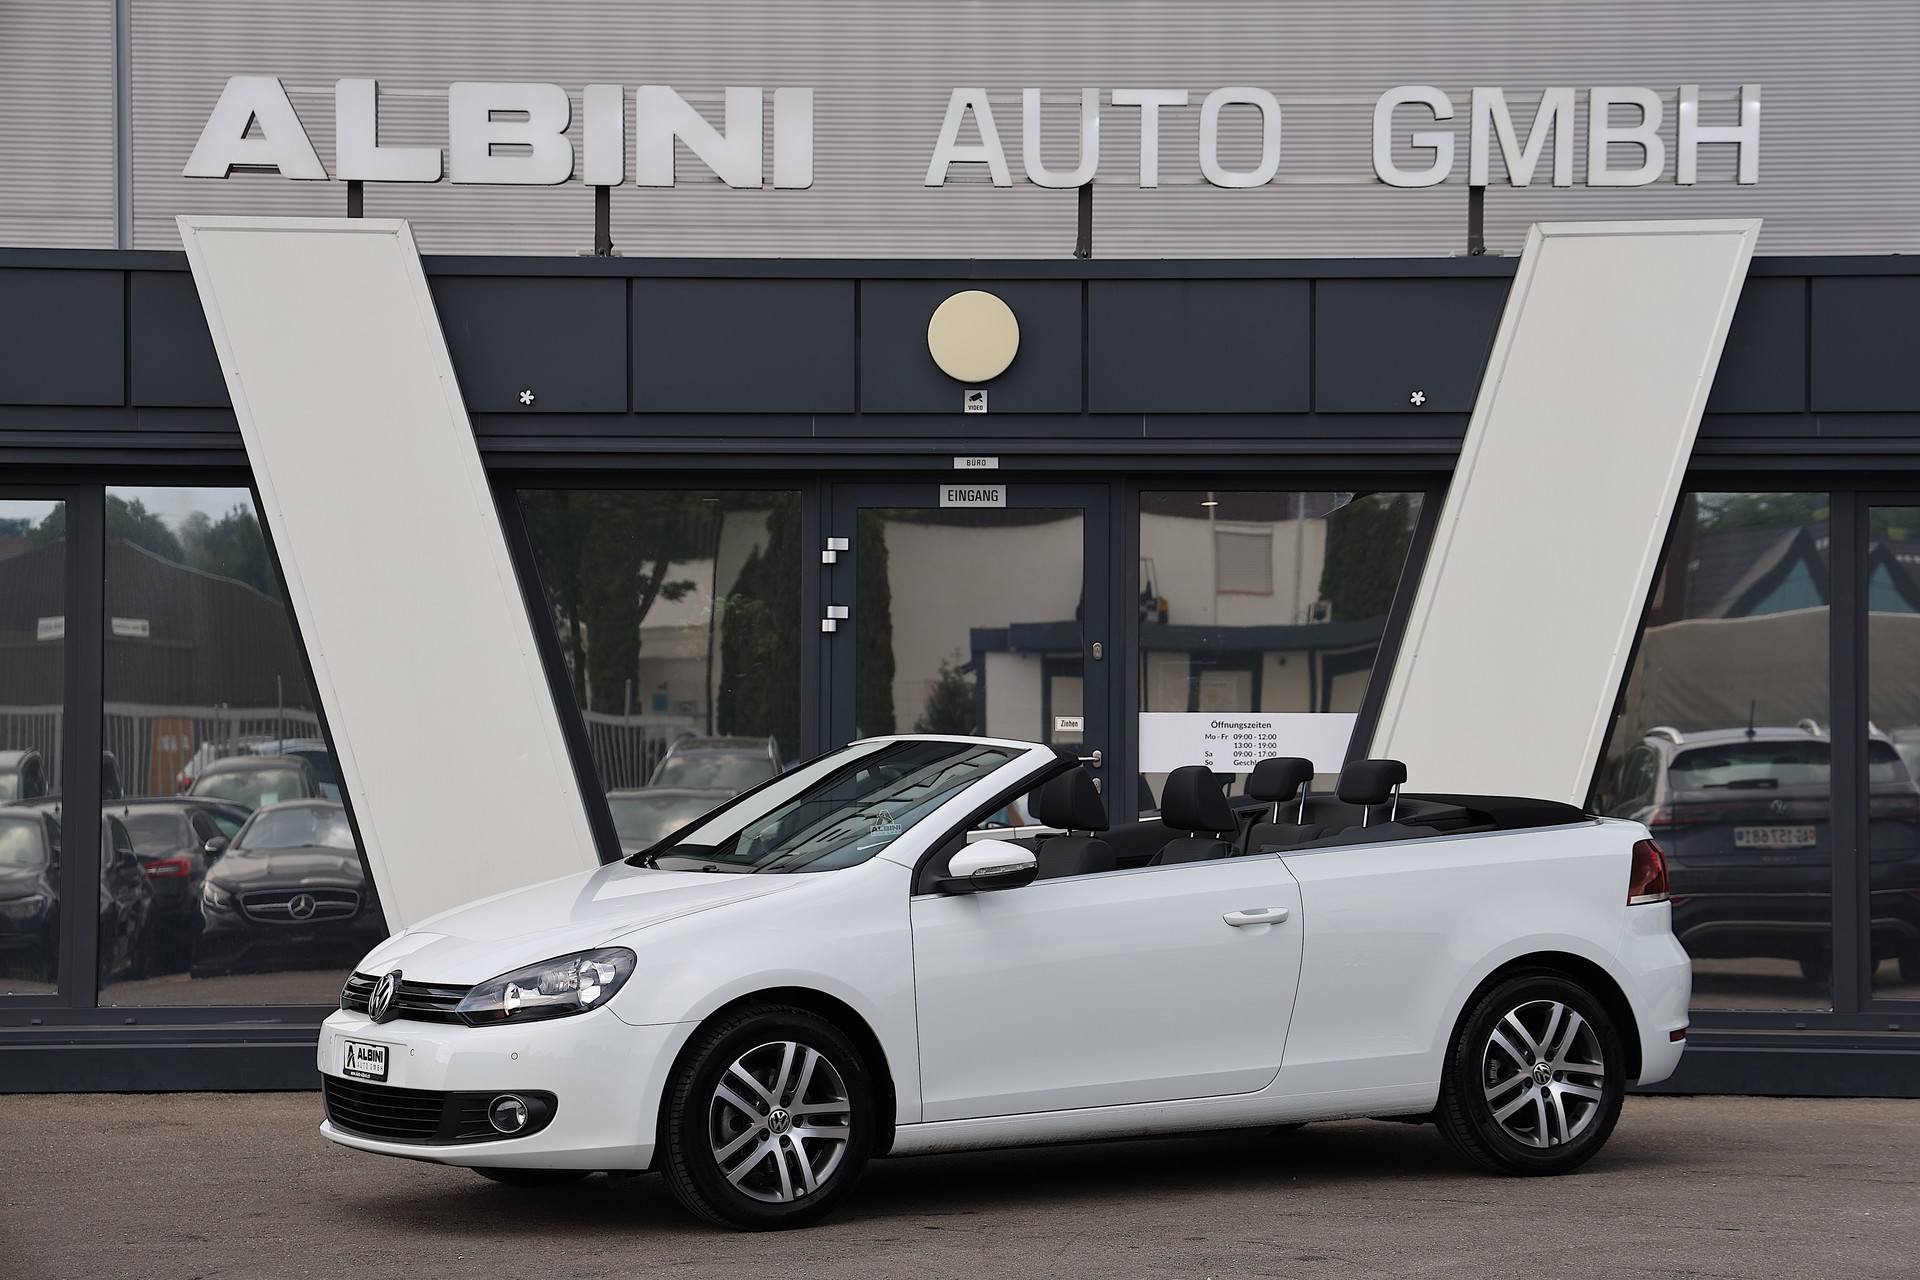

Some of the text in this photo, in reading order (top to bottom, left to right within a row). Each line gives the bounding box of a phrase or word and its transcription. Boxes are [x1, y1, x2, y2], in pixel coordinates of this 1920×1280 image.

[182, 76, 1763, 190] ALBINI AUTO GMBH
[966, 457, 987, 466] BÜRO
[947, 489, 999, 502] EINGANG
[1060, 719, 1079, 728] Ziehen
[1210, 720, 1272, 731] Öffnungszeiten
[871, 824, 901, 832] ALBINI
[357, 1047, 383, 1064] ALBINI
